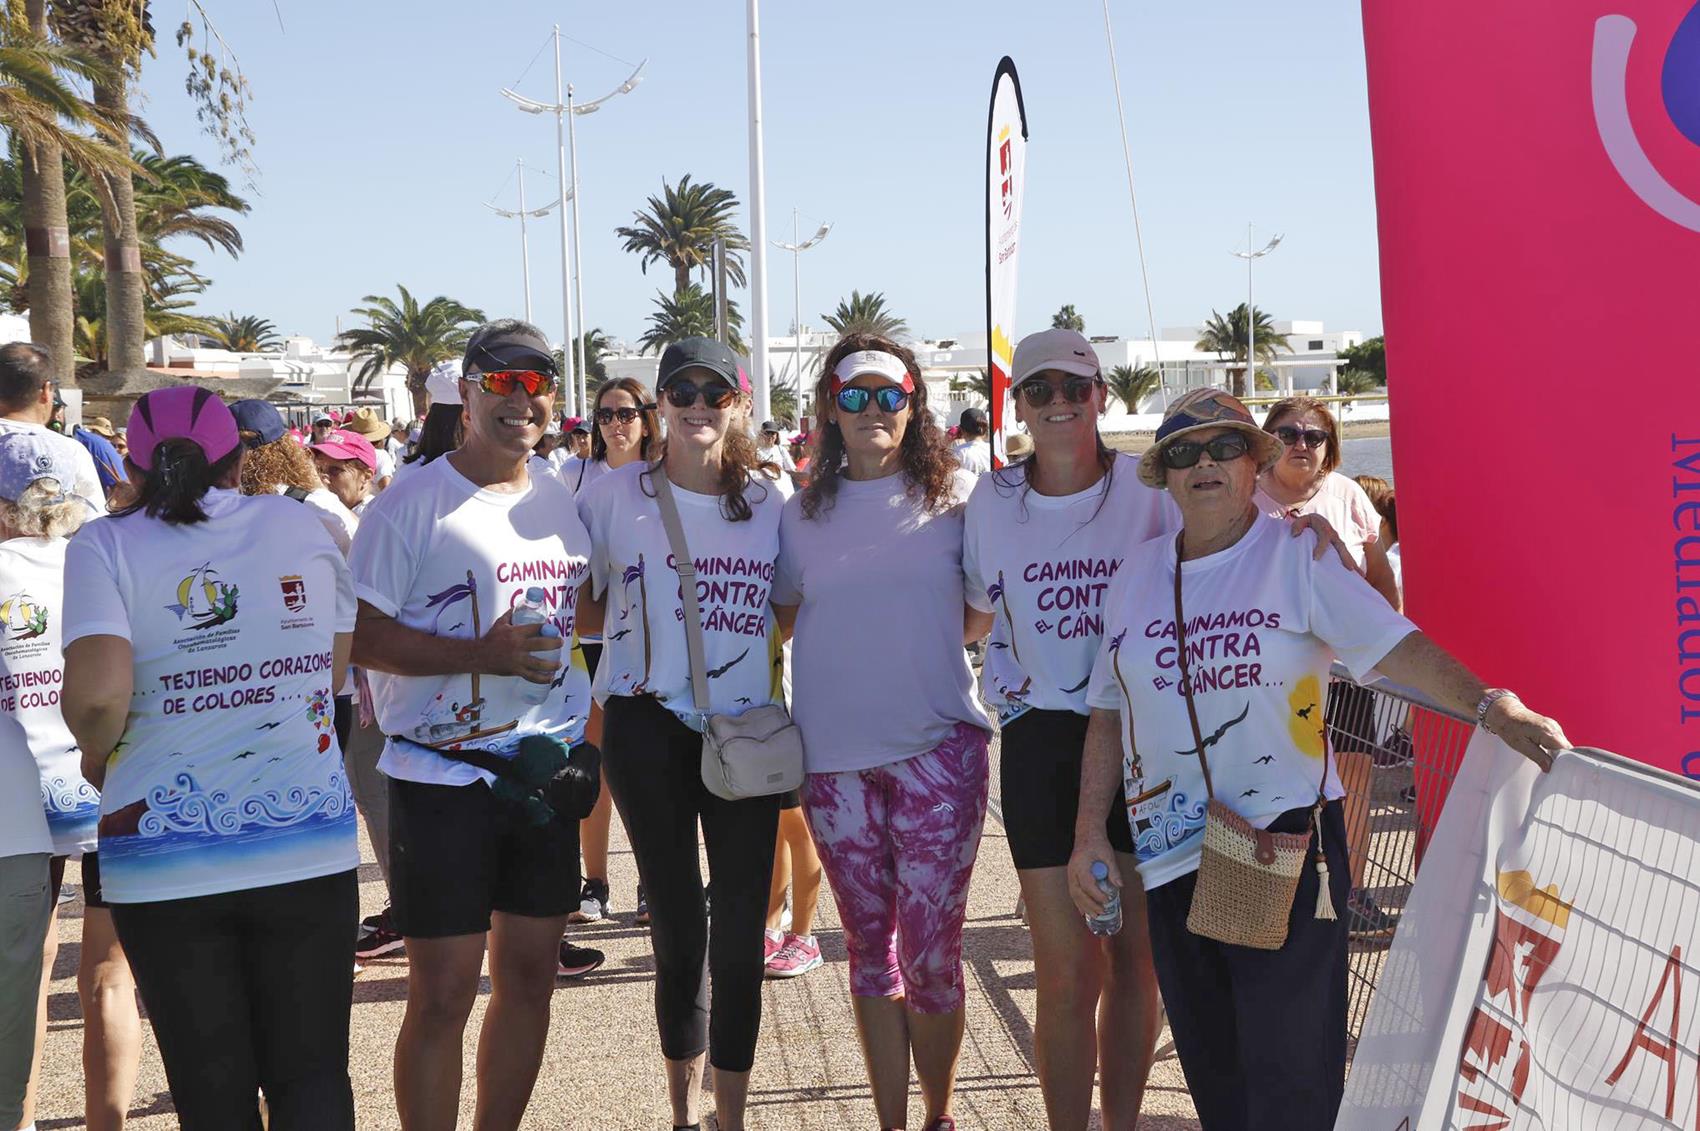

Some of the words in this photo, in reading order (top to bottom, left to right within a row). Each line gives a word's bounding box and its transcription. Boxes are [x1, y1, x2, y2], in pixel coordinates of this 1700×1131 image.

[666, 554, 775, 583] CMINAMOS
[510, 585, 578, 610] CNTR
[699, 605, 765, 638] ÁNCER
[1034, 619, 1054, 634] EL
[1057, 609, 1104, 640] CÁN
[1155, 632, 1261, 669] CONTRA
[259, 651, 332, 680] CORAZONE
[1152, 675, 1174, 691] EL
[20, 690, 64, 709] COLO
[163, 698, 186, 715] DE
